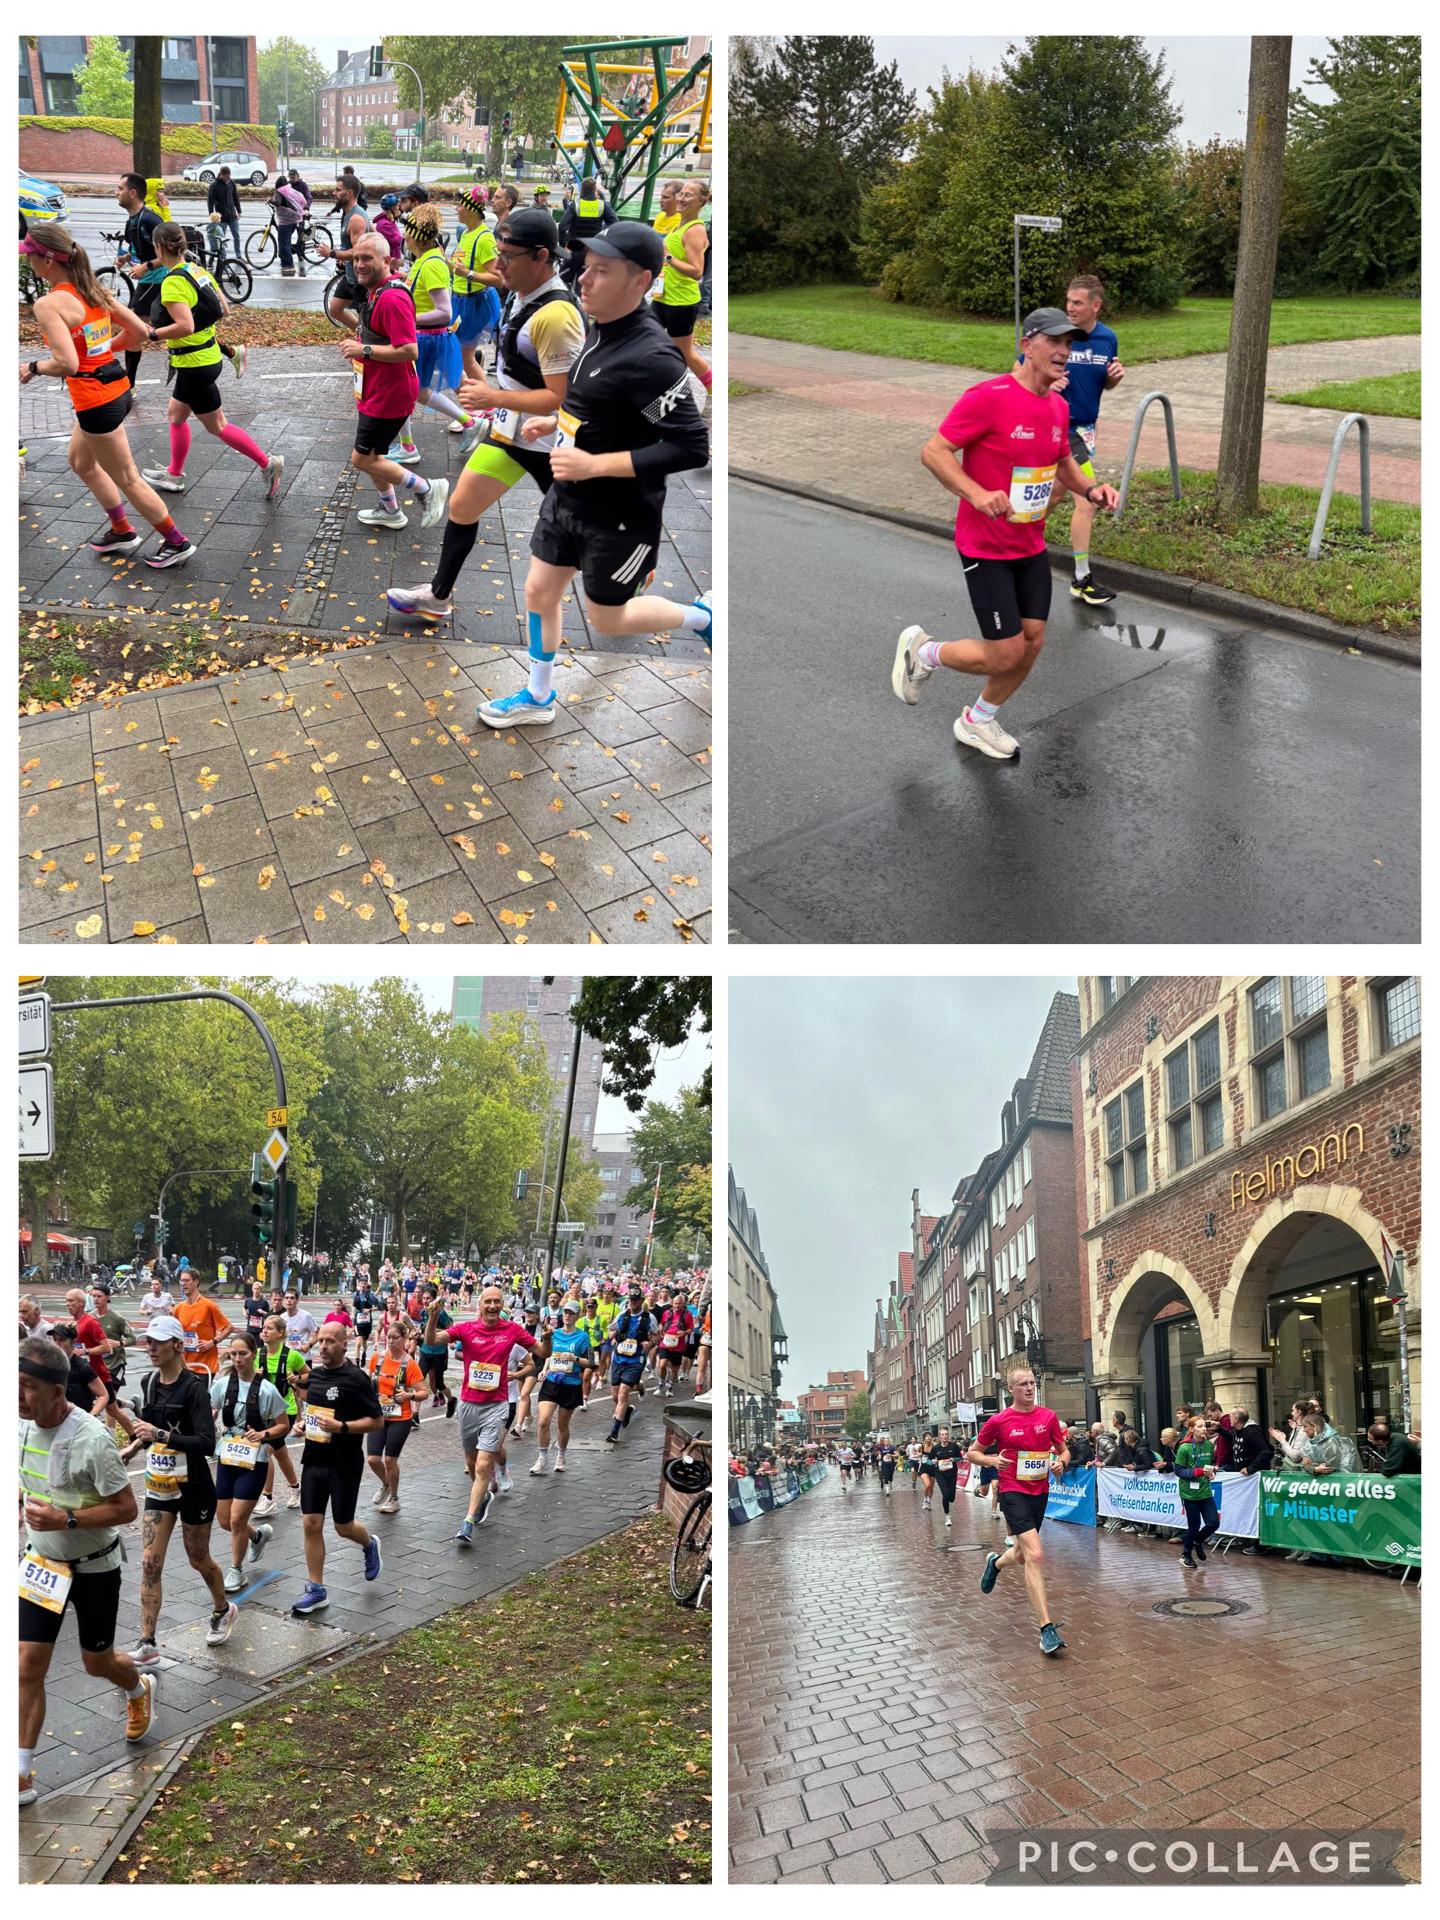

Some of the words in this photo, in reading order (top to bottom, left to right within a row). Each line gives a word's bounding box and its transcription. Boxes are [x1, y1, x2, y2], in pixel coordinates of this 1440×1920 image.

[91, 330, 99, 341] 28
[100, 325, 109, 337] KM
[1024, 482, 1052, 501] 5286
[993, 611, 1002, 630] FUSION
[271, 1111, 282, 1124] 54
[1231, 1123, 1364, 1210] fielmann
[473, 1371, 494, 1381] 5225
[306, 1414, 319, 1427] 536
[227, 1443, 251, 1456] 5425
[151, 1454, 177, 1467] 5443
[1025, 1460, 1046, 1469] 5654
[1123, 1477, 1178, 1493] Volksbanken
[1262, 1477, 1287, 1493] Wir
[1288, 1479, 1341, 1498] geben
[1345, 1480, 1397, 1500] alles
[1108, 1494, 1175, 1514] Raiffeisenbanken
[1283, 1500, 1358, 1524] Münster
[25, 1562, 58, 1589] 5131
